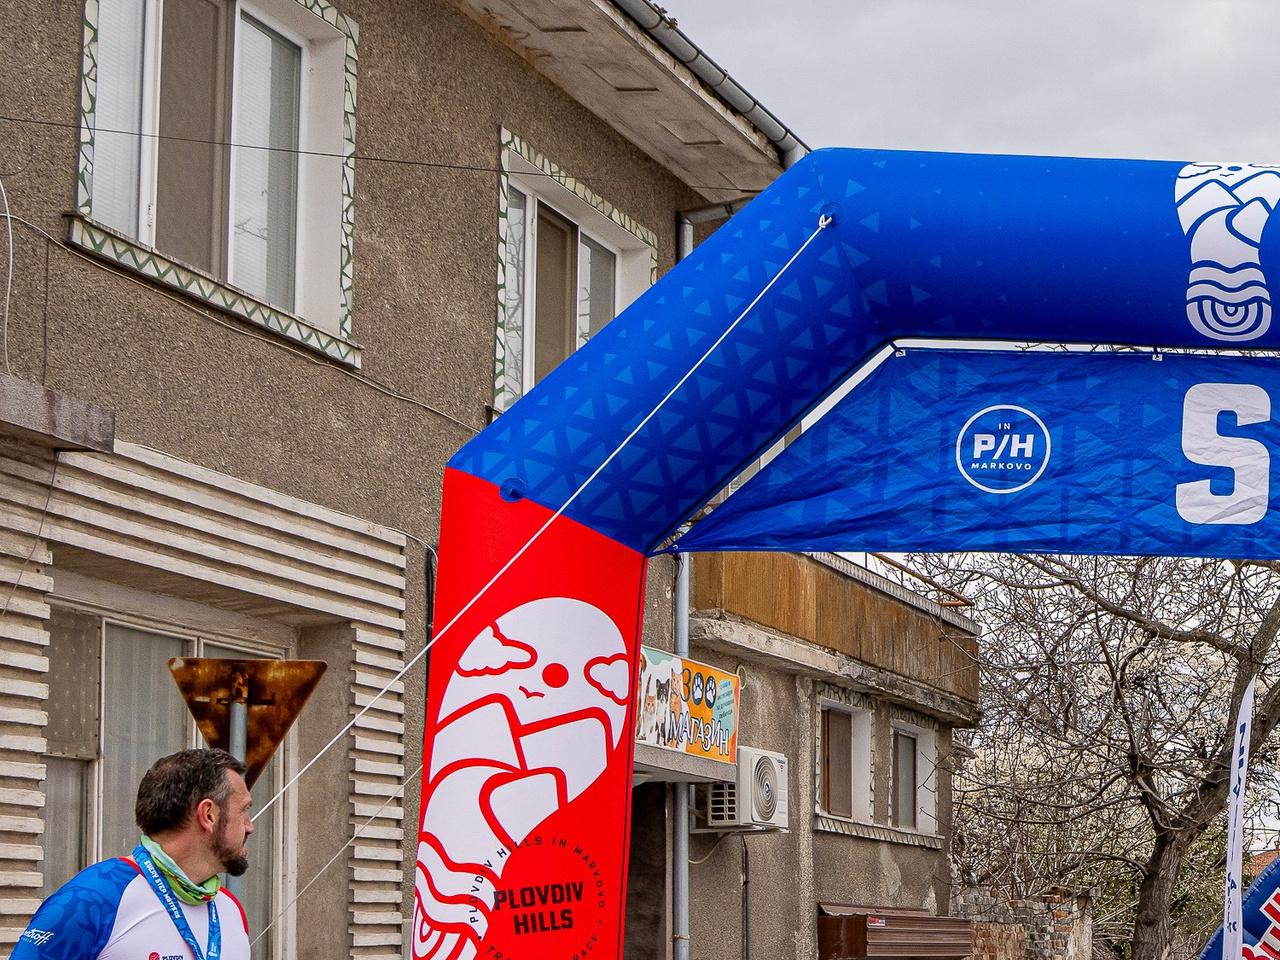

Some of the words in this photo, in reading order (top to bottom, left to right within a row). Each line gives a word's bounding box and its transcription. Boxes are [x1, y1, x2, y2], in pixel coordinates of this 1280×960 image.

[973, 434, 1034, 460] P/H
[971, 462, 1032, 470] MARKOVO
[669, 710, 730, 755] МАГАЗИН
[468, 860, 494, 924] PLOVDIV
[496, 836, 543, 858] HILLS
[552, 837, 567, 848] IN
[573, 846, 606, 908] MARKOVO
[493, 881, 584, 911] PLOVDIV
[513, 908, 574, 935] HILLS
